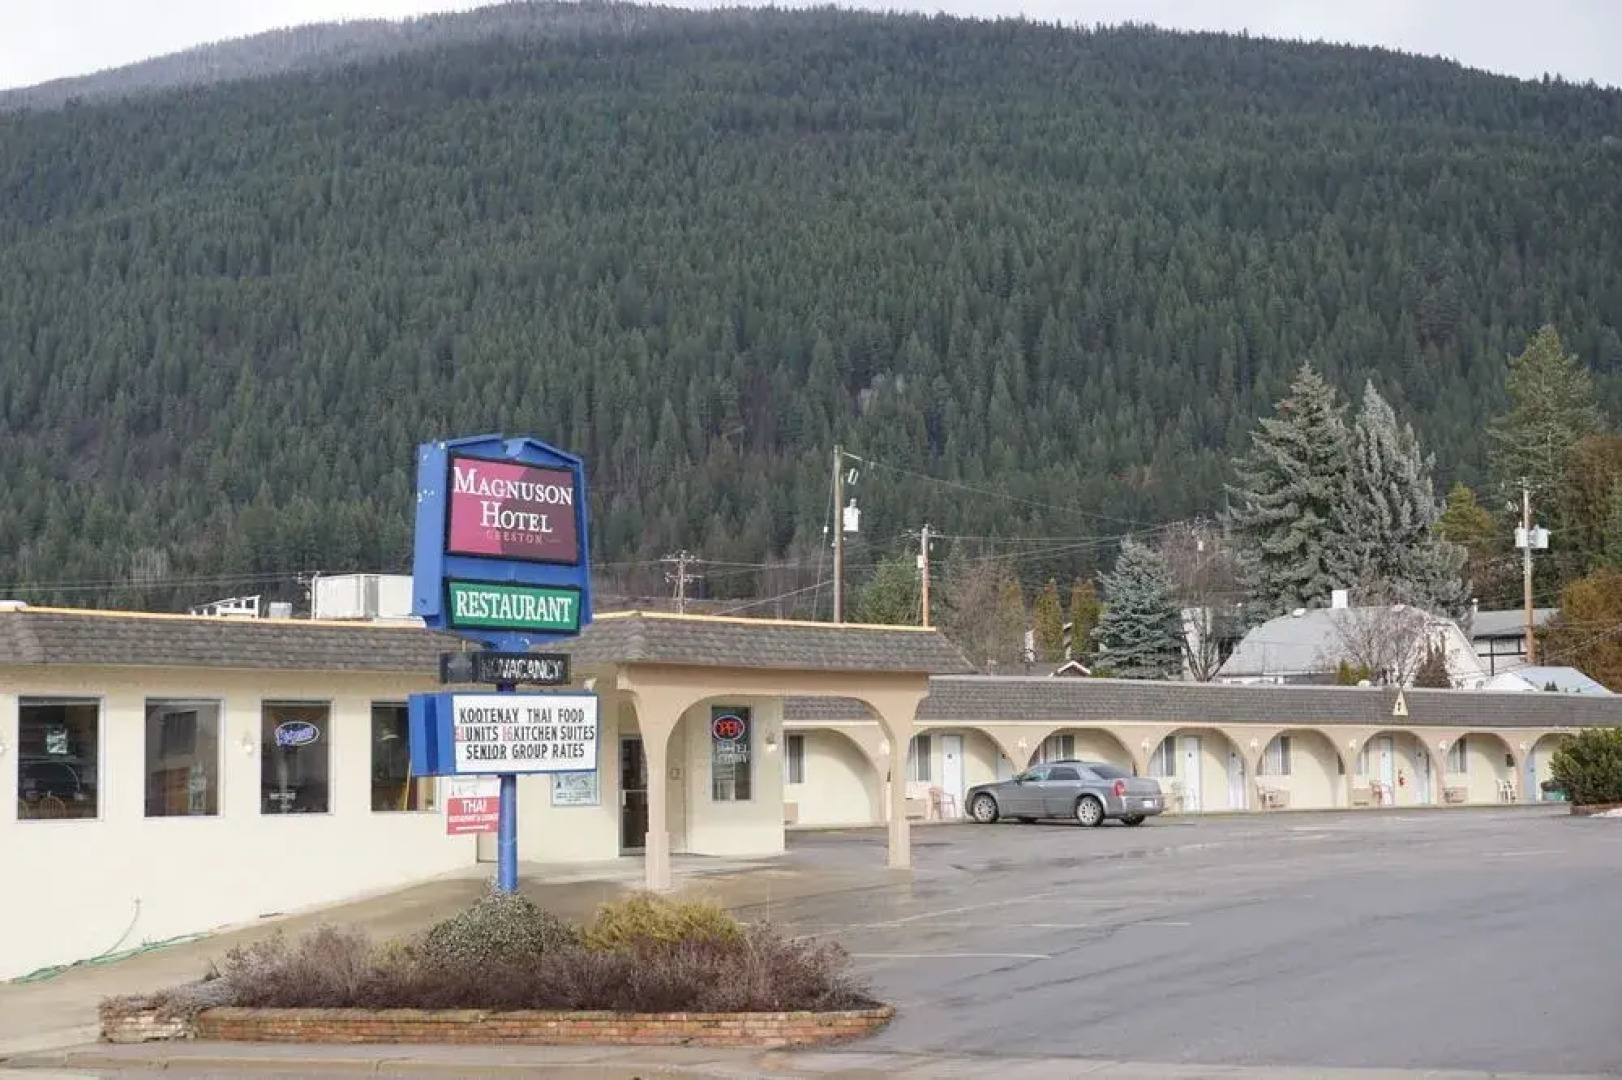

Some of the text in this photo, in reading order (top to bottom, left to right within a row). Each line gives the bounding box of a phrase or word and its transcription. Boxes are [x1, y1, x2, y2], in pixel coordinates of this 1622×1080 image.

[453, 466, 573, 506] MAGNUSON
[480, 500, 552, 533] HOTEL
[486, 529, 543, 545] CRESTON
[456, 590, 571, 623] RESTAURANT
[500, 658, 563, 680] VACANCY
[459, 708, 585, 723] KOOTENAY THAI FOOD
[560, 724, 595, 741] SUITES
[466, 743, 585, 760] SENIOR GROUP RATES
[462, 799, 487, 815] THAI
